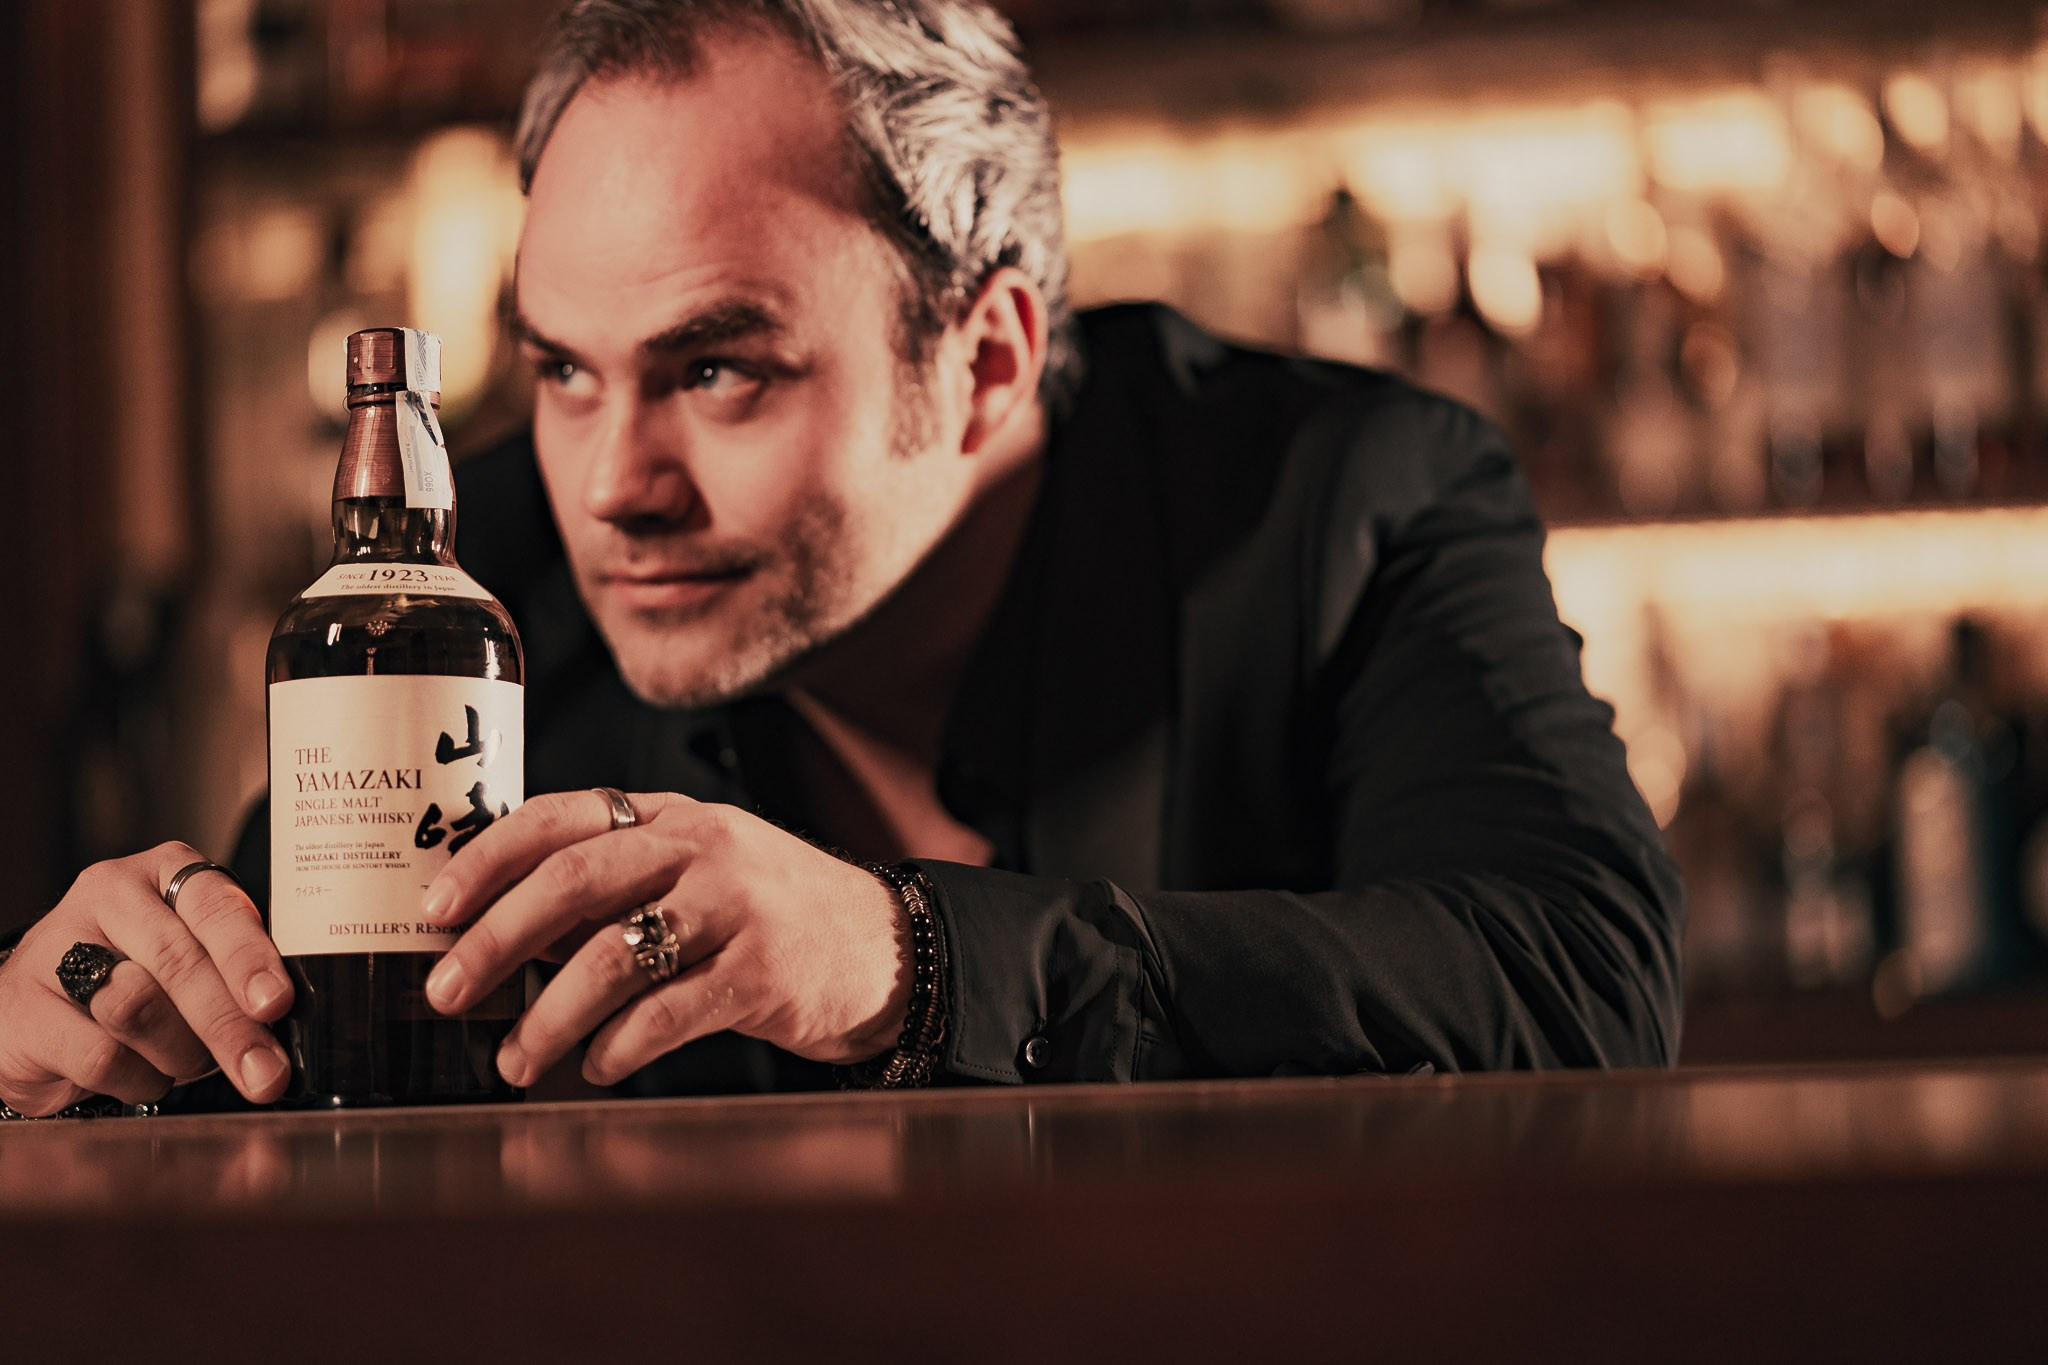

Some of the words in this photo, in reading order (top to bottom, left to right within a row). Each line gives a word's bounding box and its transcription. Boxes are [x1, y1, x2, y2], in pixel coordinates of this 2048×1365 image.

[337, 573, 366, 581] SINCE
[368, 569, 429, 583] 1923
[383, 583, 421, 591] distillery
[295, 746, 332, 765] THE
[295, 769, 422, 792] YAMAZAKI
[295, 798, 338, 811] SINGLE
[342, 796, 383, 808] MALT
[295, 813, 355, 827] JAPANESE
[358, 811, 415, 824] WHISKY
[295, 843, 304, 851] The
[305, 842, 323, 850] oldest
[324, 841, 353, 850] distillery
[364, 841, 385, 850] Japan
[295, 853, 339, 863] YAMAZAKI
[343, 851, 402, 861] DISTILLERY
[329, 921, 411, 935] DISTILLER'S
